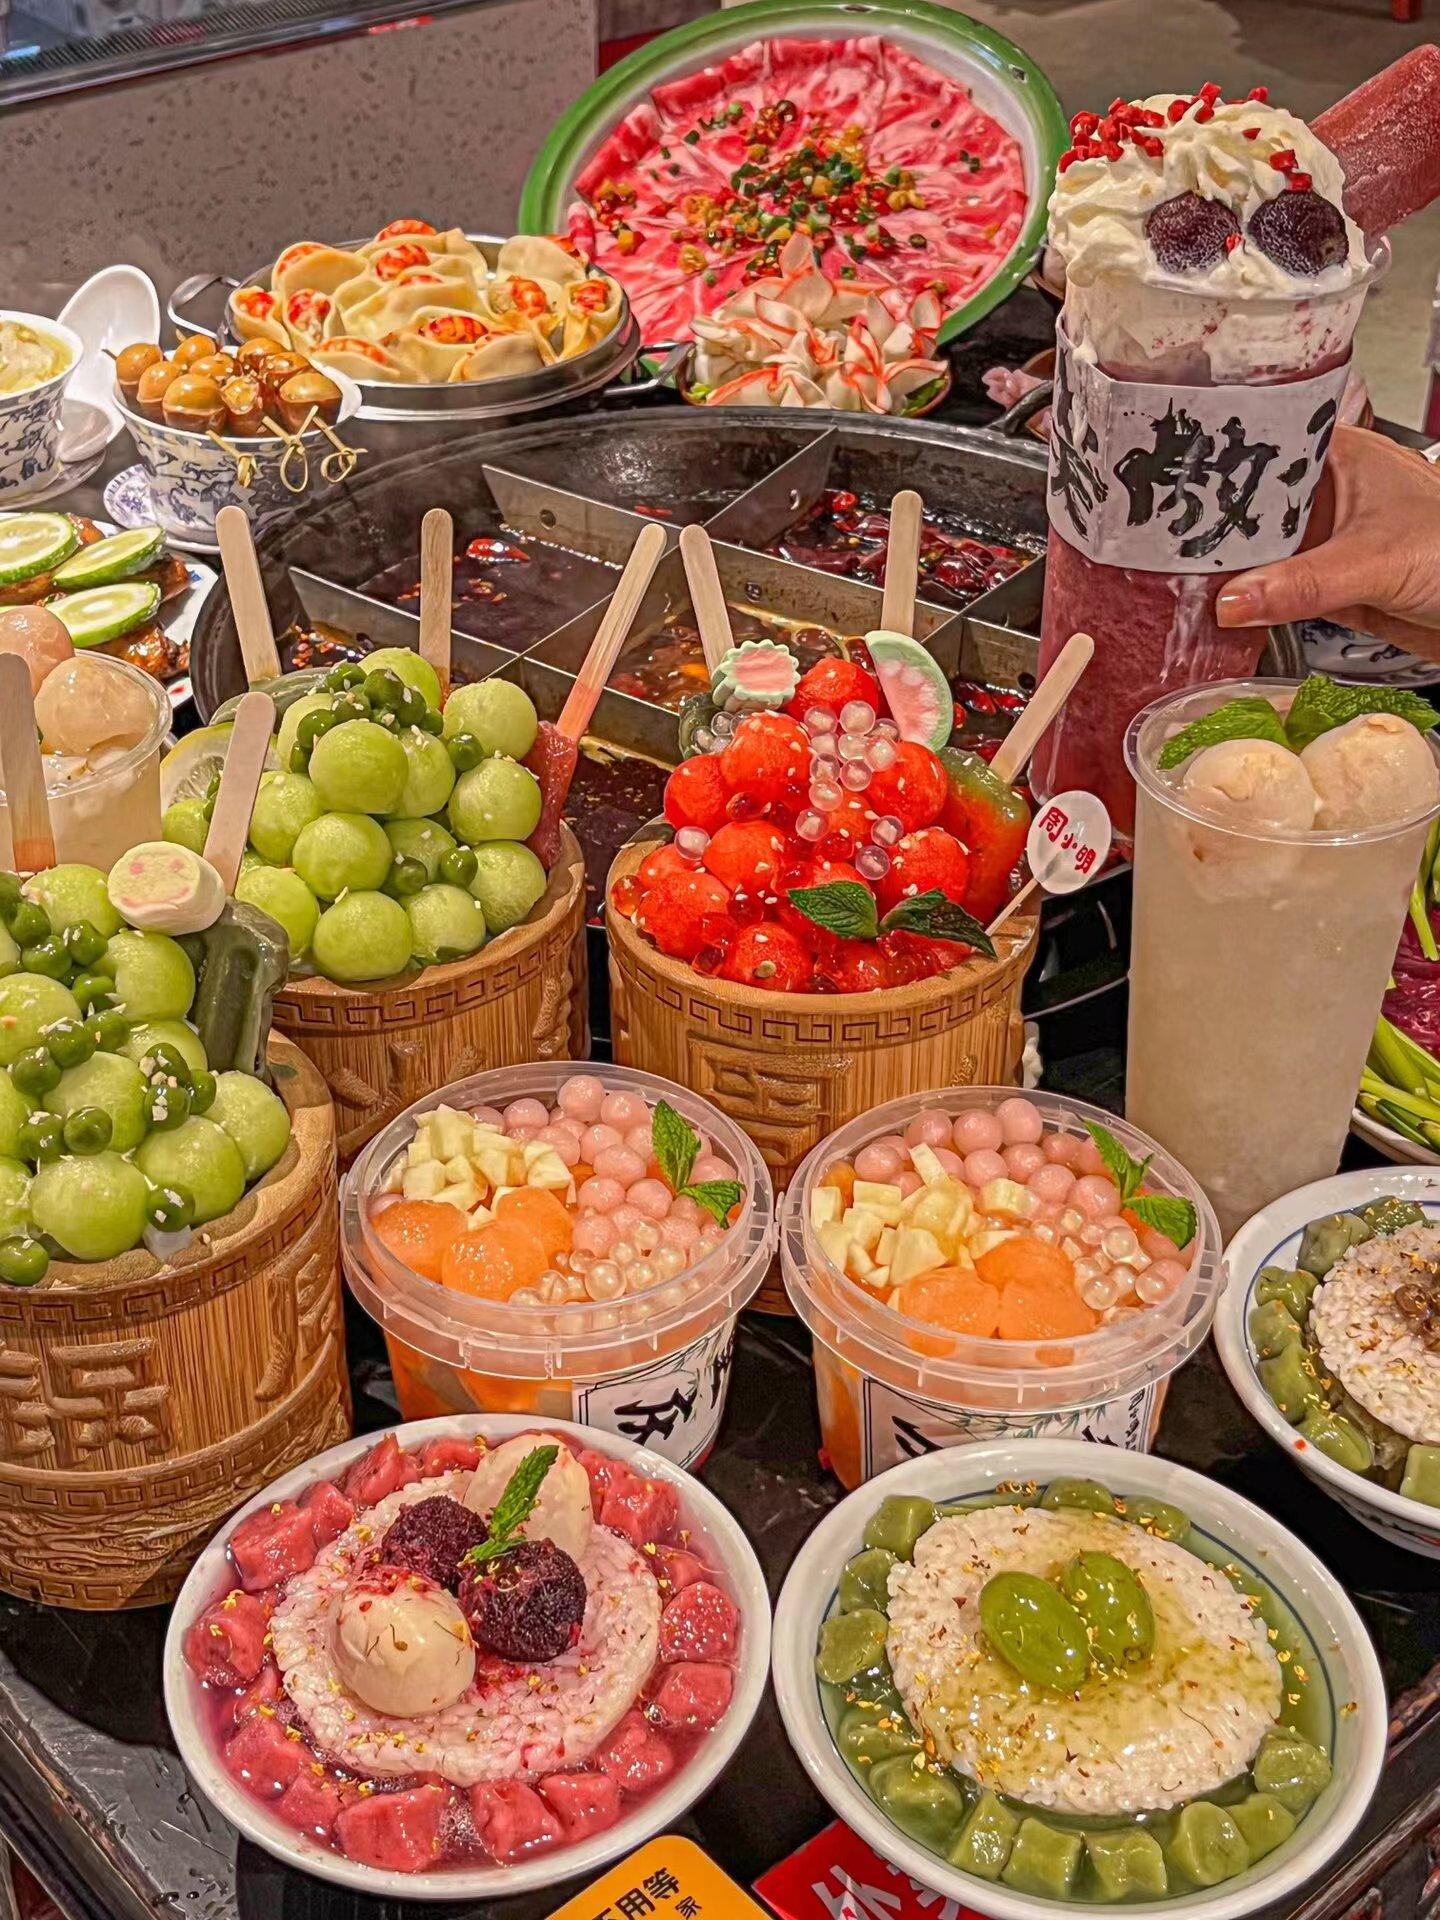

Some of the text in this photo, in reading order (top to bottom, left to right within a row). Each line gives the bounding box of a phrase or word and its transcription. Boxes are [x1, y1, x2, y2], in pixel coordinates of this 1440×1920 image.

[1039, 806, 1096, 874] 周小明
[675, 1896, 702, 1920] 家
